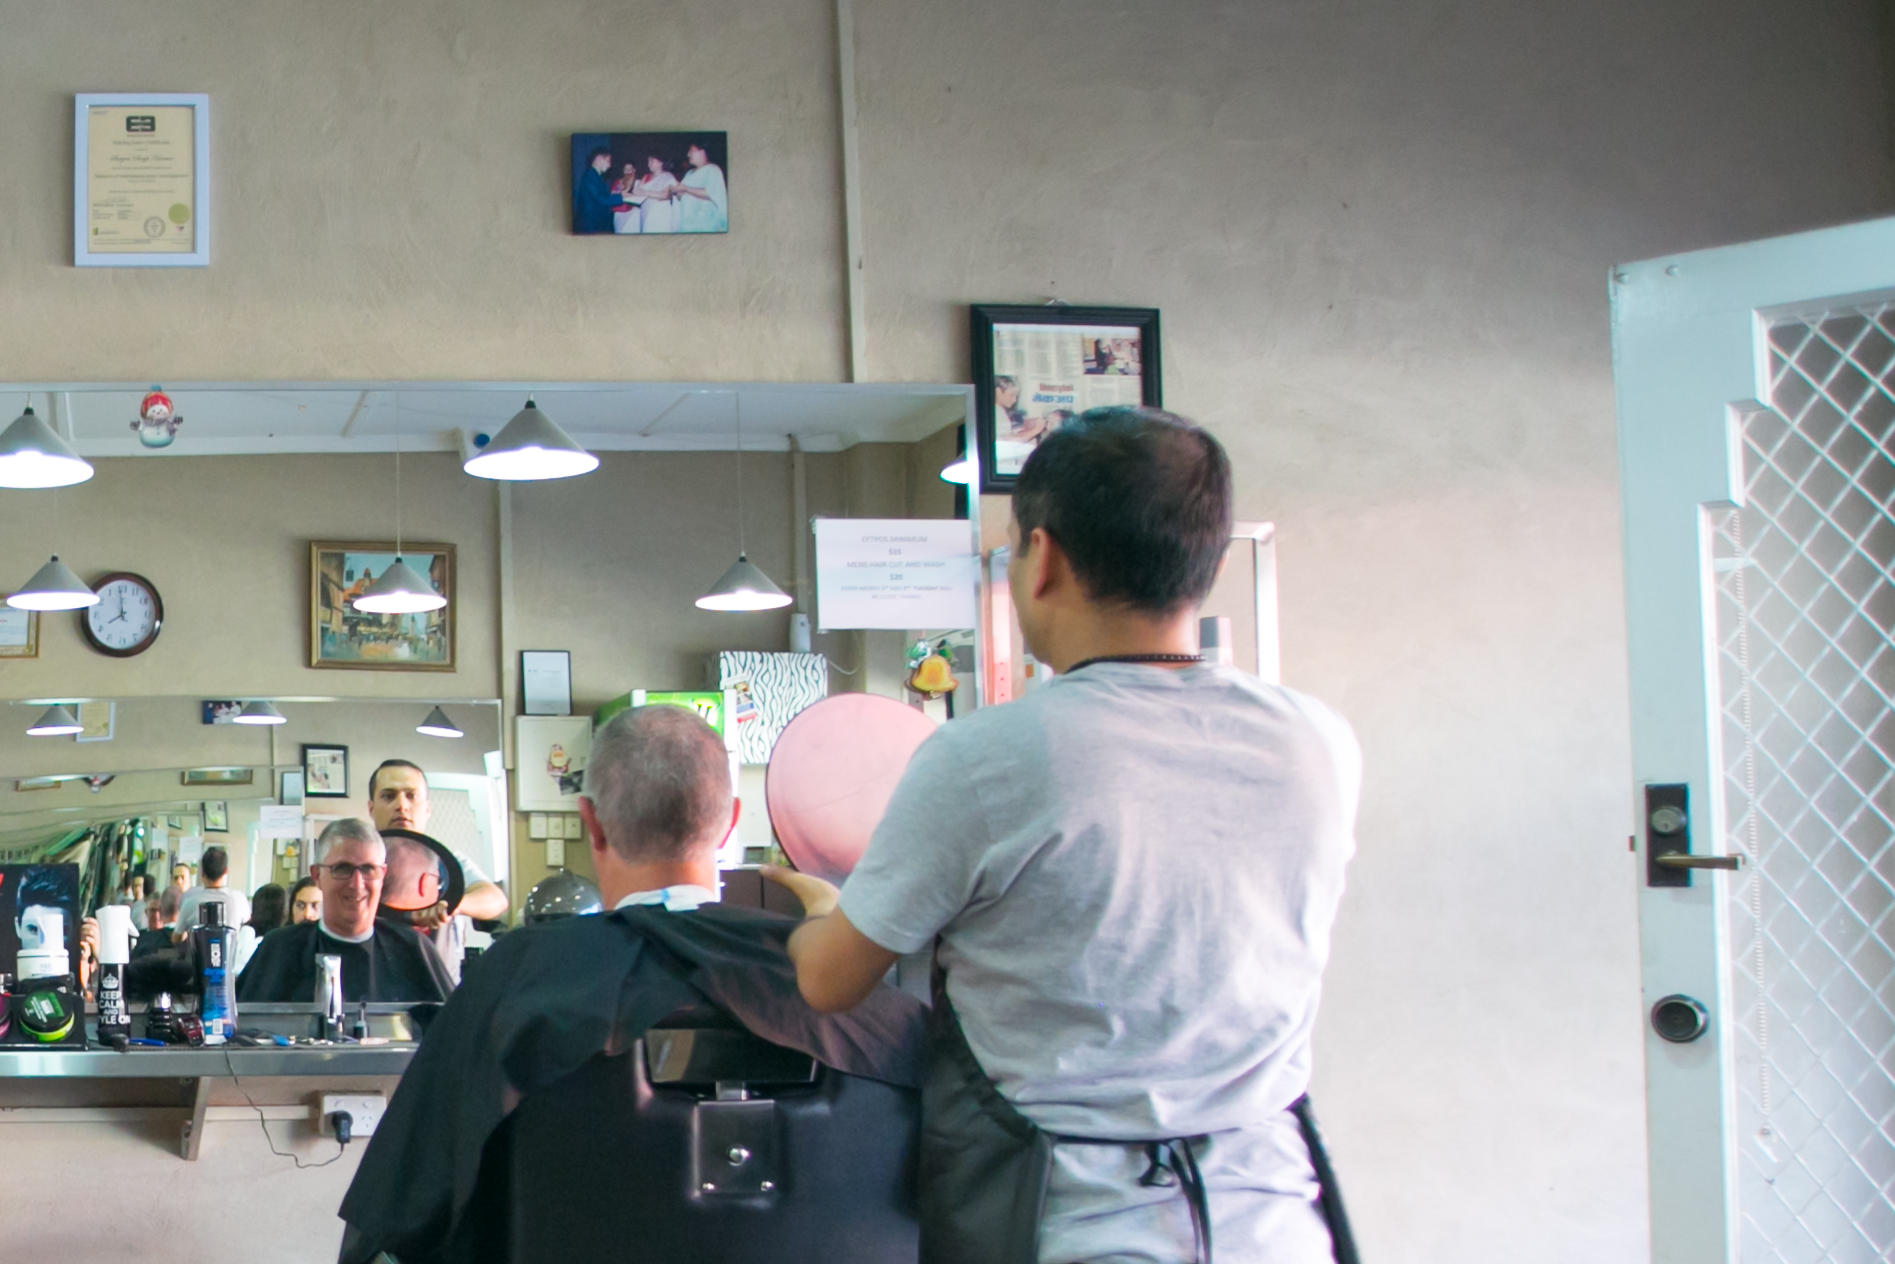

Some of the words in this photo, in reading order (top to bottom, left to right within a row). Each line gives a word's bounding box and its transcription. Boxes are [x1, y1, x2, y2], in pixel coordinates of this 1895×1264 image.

[100, 990, 122, 1000] KEEP
[98, 1000, 125, 1009] CALM
[98, 1015, 117, 1025] YLE
[118, 1015, 131, 1025] ON
